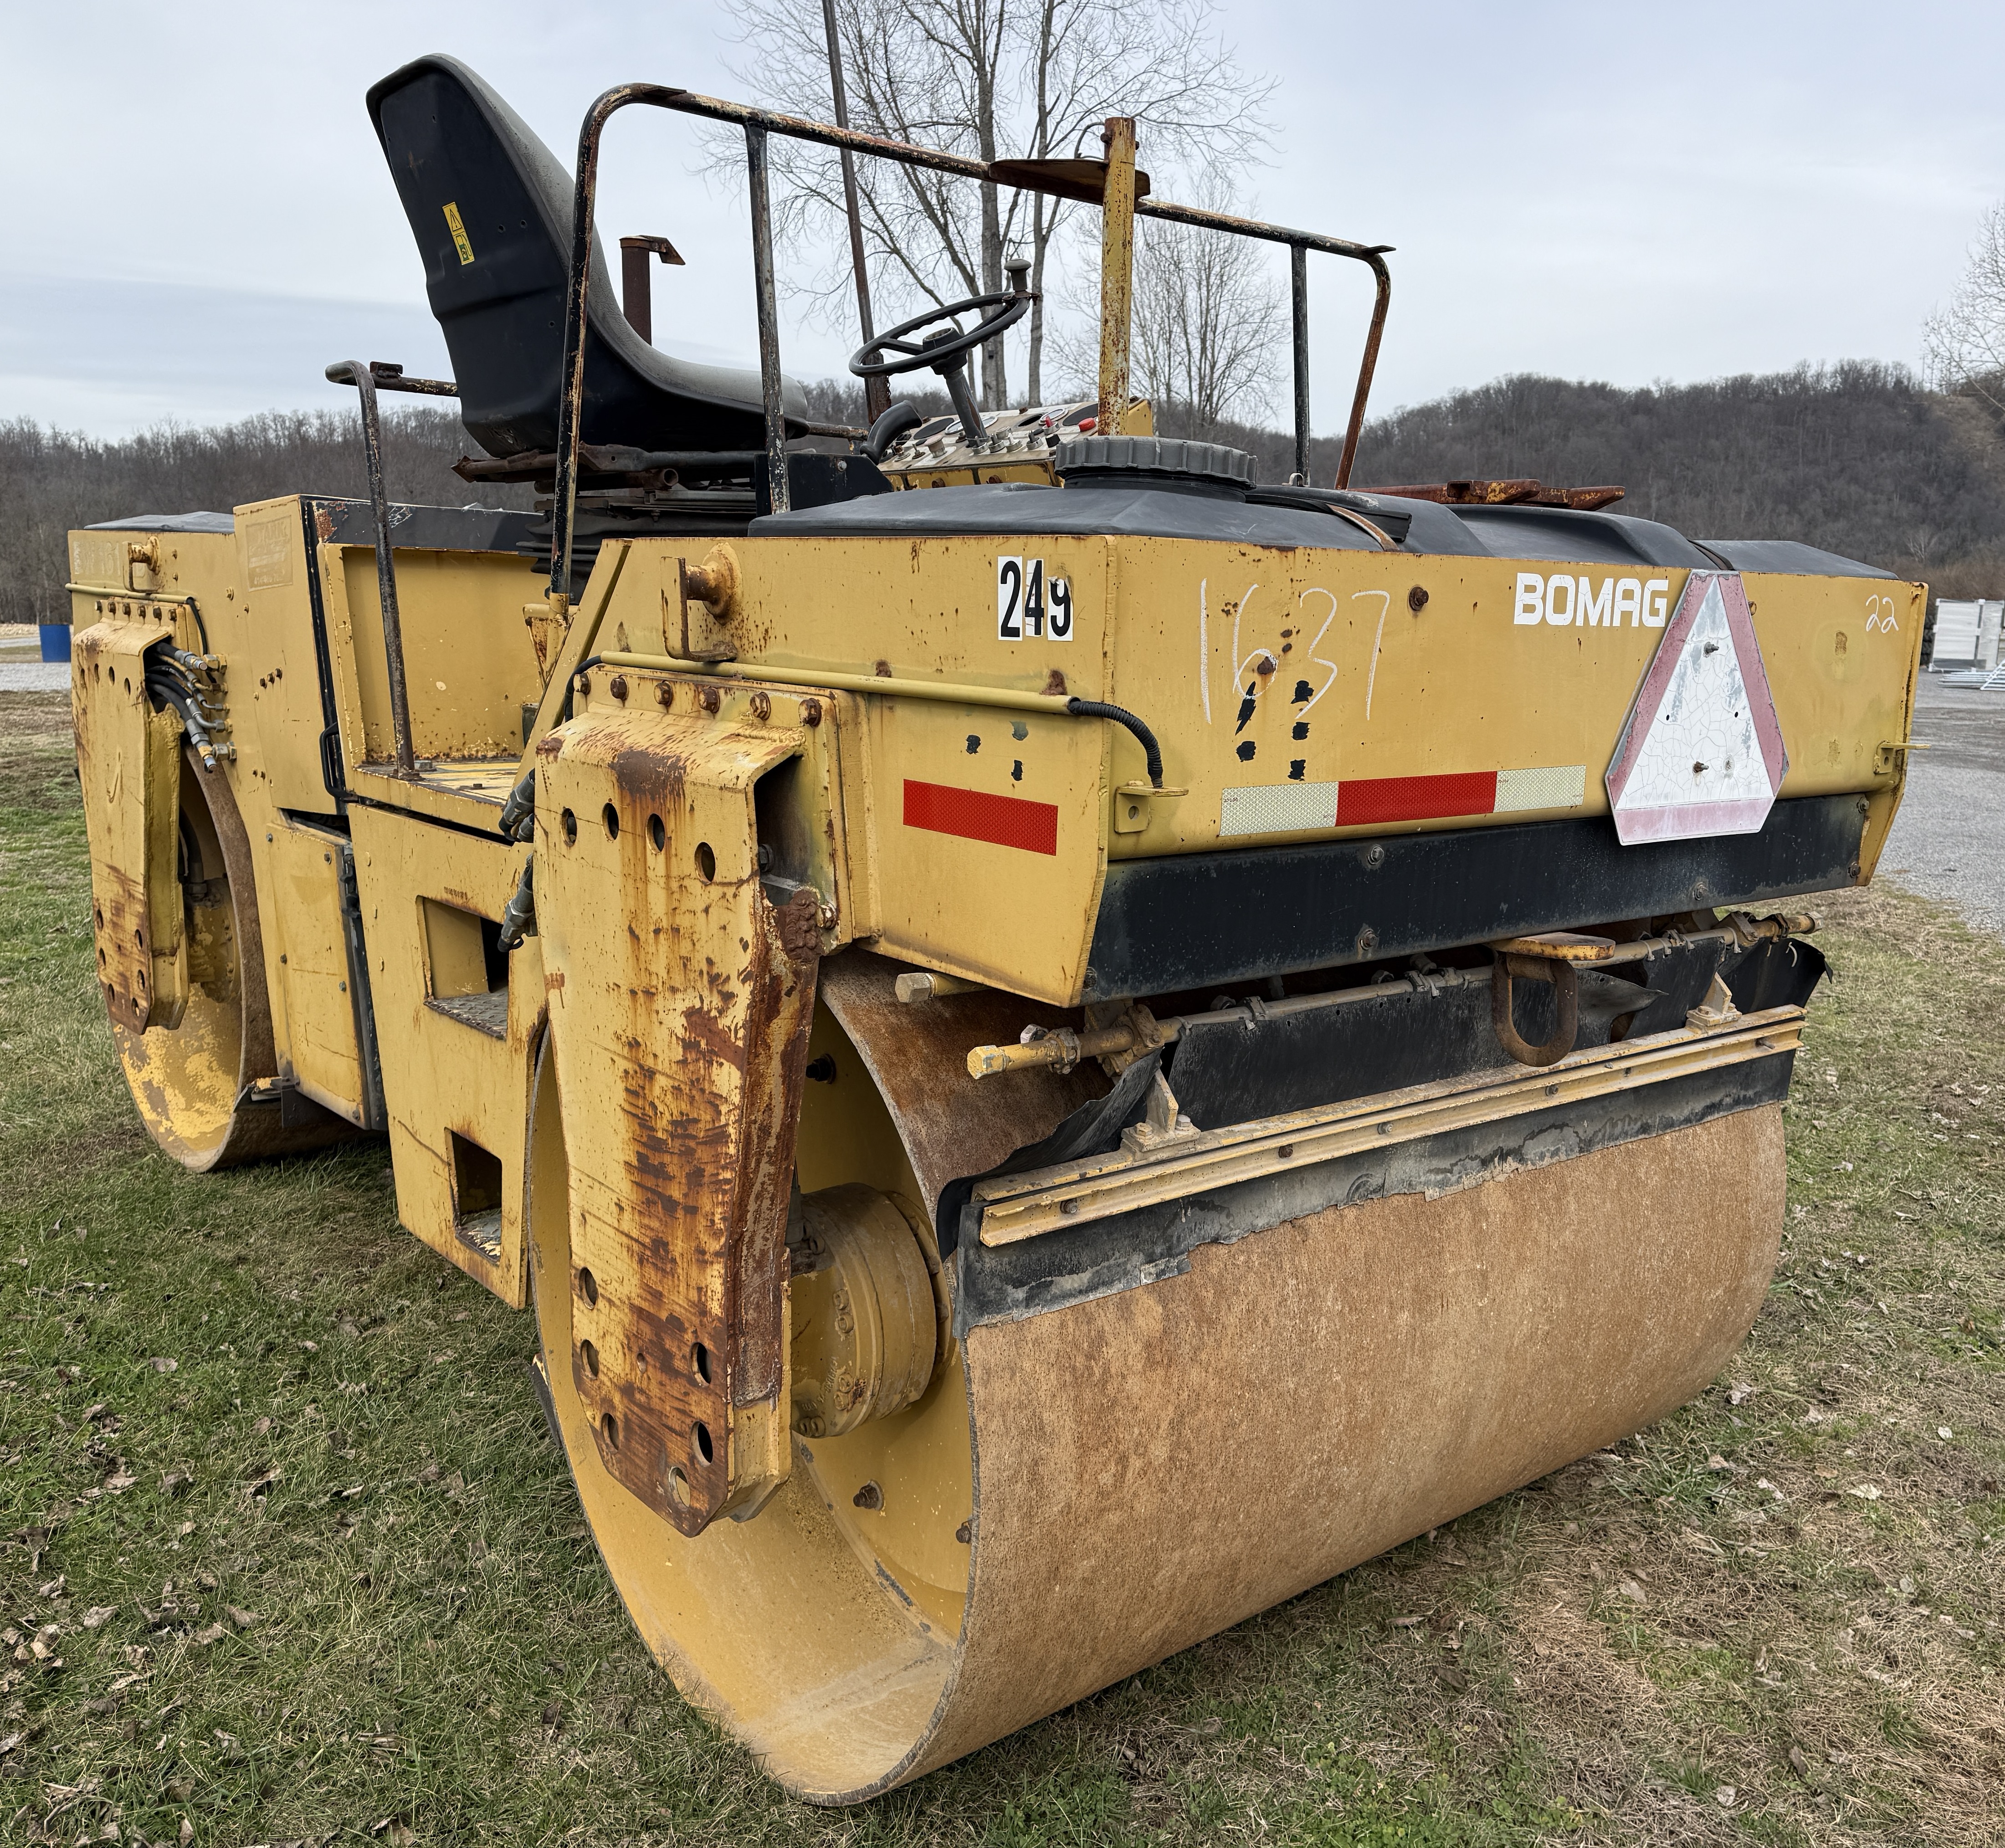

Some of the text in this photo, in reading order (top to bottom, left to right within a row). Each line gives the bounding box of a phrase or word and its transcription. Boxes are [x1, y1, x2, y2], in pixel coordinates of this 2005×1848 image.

[1000, 560, 1071, 637] 249
[1514, 573, 1669, 627] BOMAG
[1866, 594, 1899, 634] 22
[1200, 578, 1390, 725] 1637
